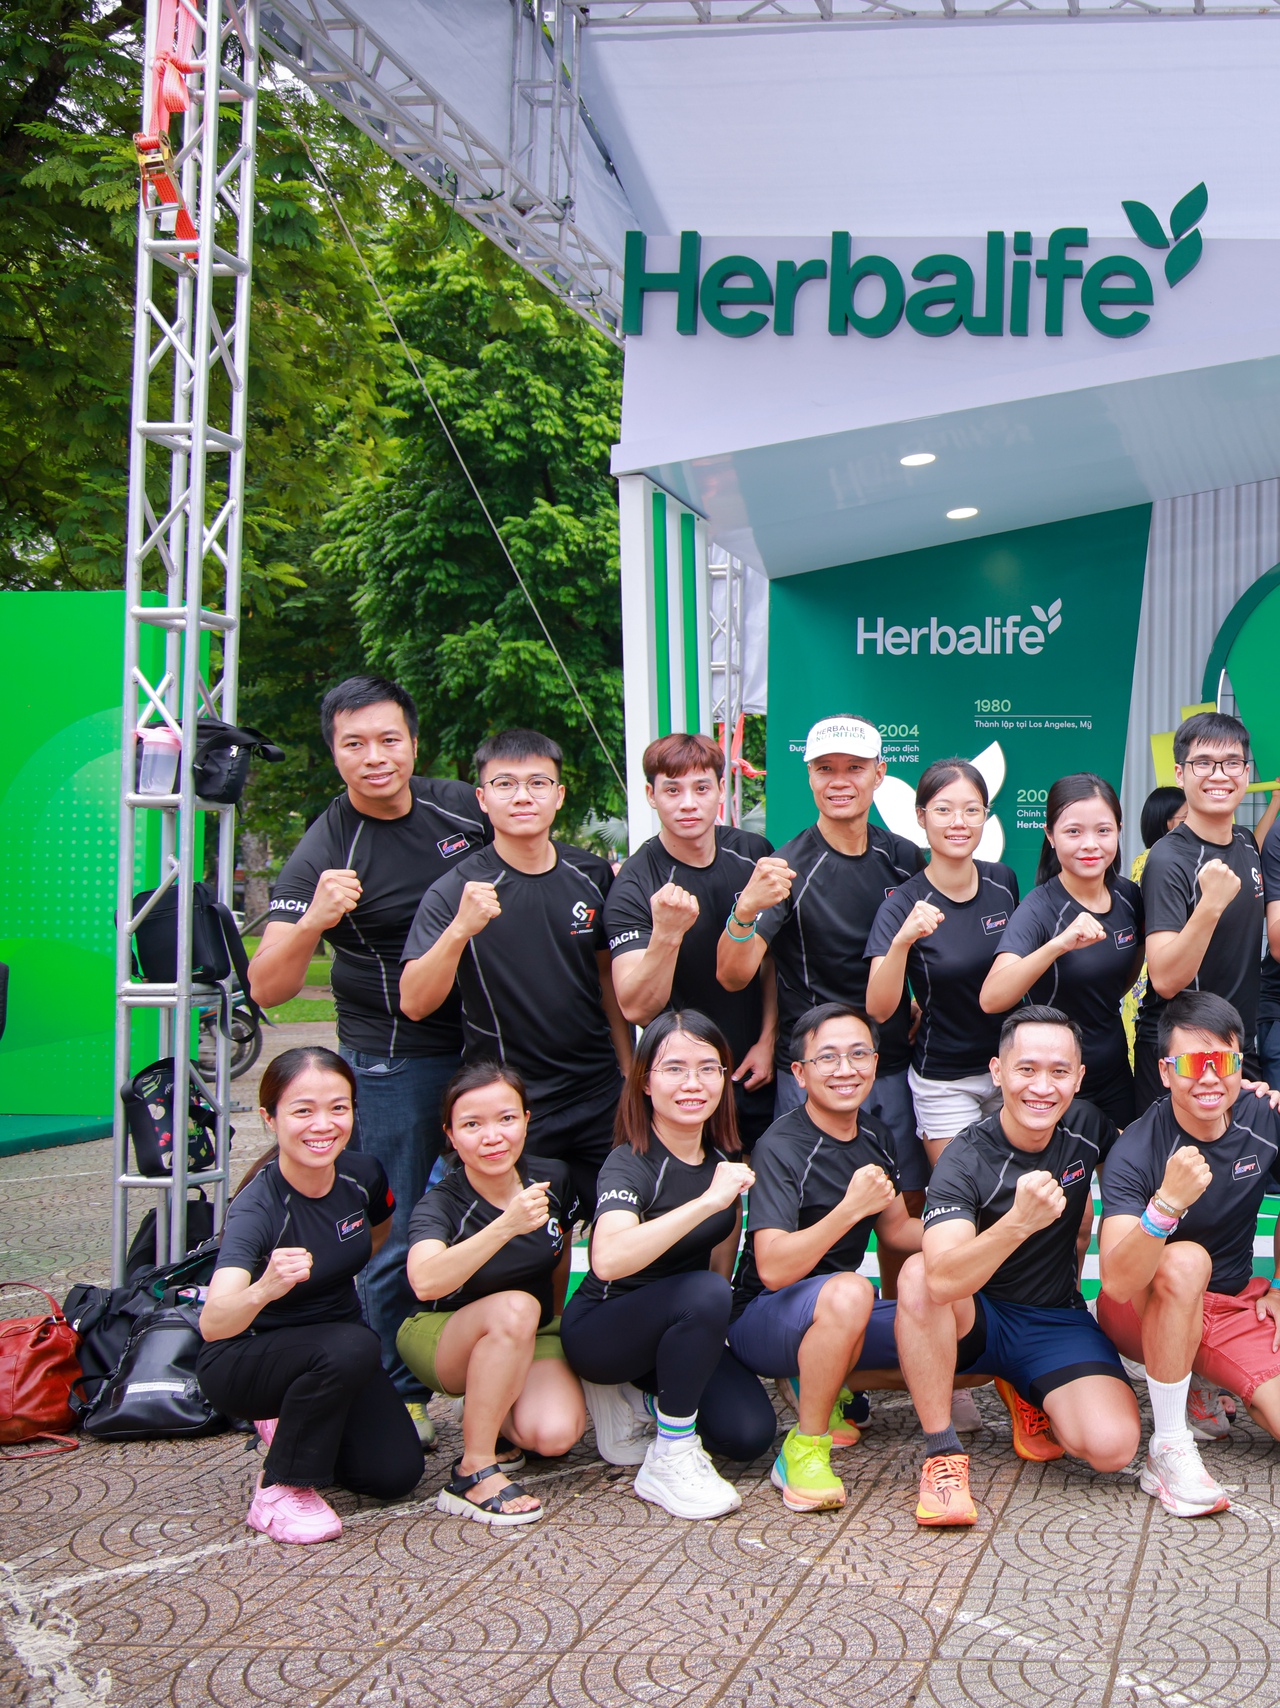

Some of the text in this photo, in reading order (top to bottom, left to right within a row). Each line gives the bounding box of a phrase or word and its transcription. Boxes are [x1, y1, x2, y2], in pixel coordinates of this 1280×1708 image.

[622, 227, 1154, 339] Herbalife
[856, 615, 1045, 655] Herbalife
[974, 699, 1011, 712] 1980
[816, 725, 865, 736] HERBALIFE
[878, 724, 919, 737] 2004
[974, 719, 1093, 730] Thành lập tại Los Angeles, Mỹ
[882, 745, 900, 753] giao
[902, 745, 919, 753] dịch
[899, 755, 919, 763] NYSE
[1016, 809, 1041, 817] Chính
[269, 899, 308, 913] OACH
